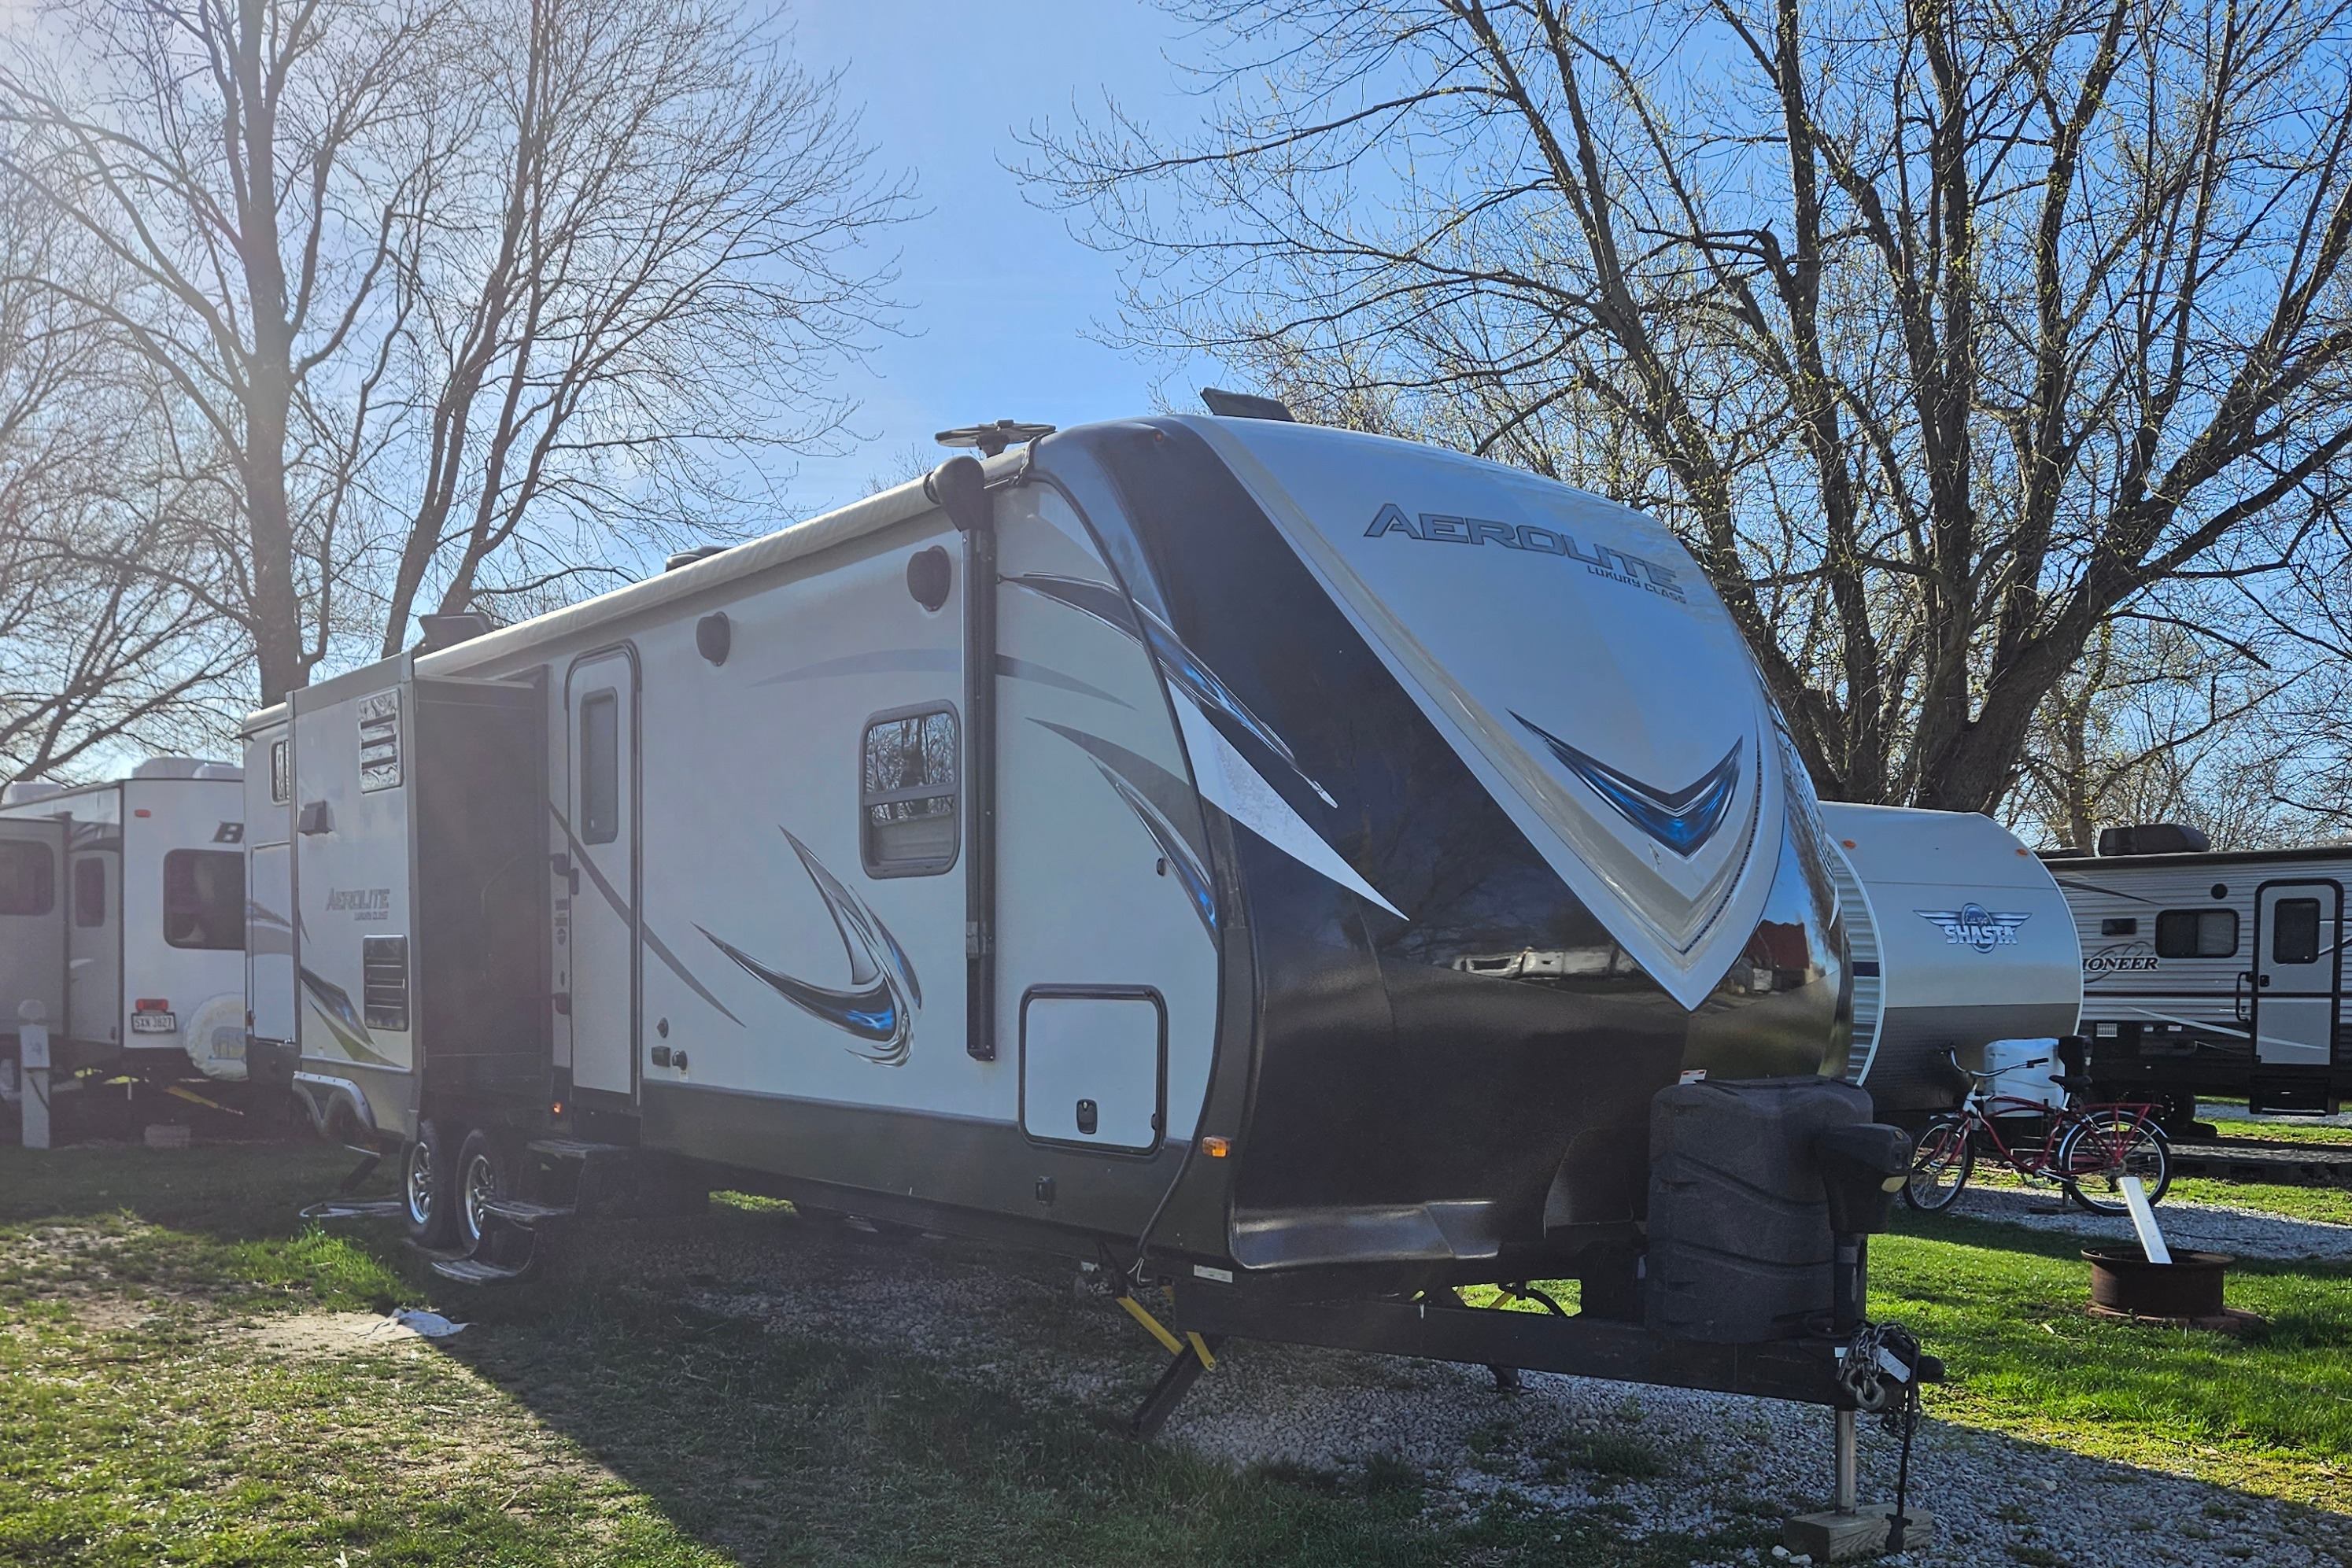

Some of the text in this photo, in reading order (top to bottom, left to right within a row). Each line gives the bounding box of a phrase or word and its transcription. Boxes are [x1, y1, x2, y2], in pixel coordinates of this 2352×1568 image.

[1364, 503, 1685, 595] AEROLITE
[1586, 565, 1687, 604] LUXURY CLASS
[326, 887, 390, 910] AEROLITE
[1944, 924, 2018, 945] SHASTA
